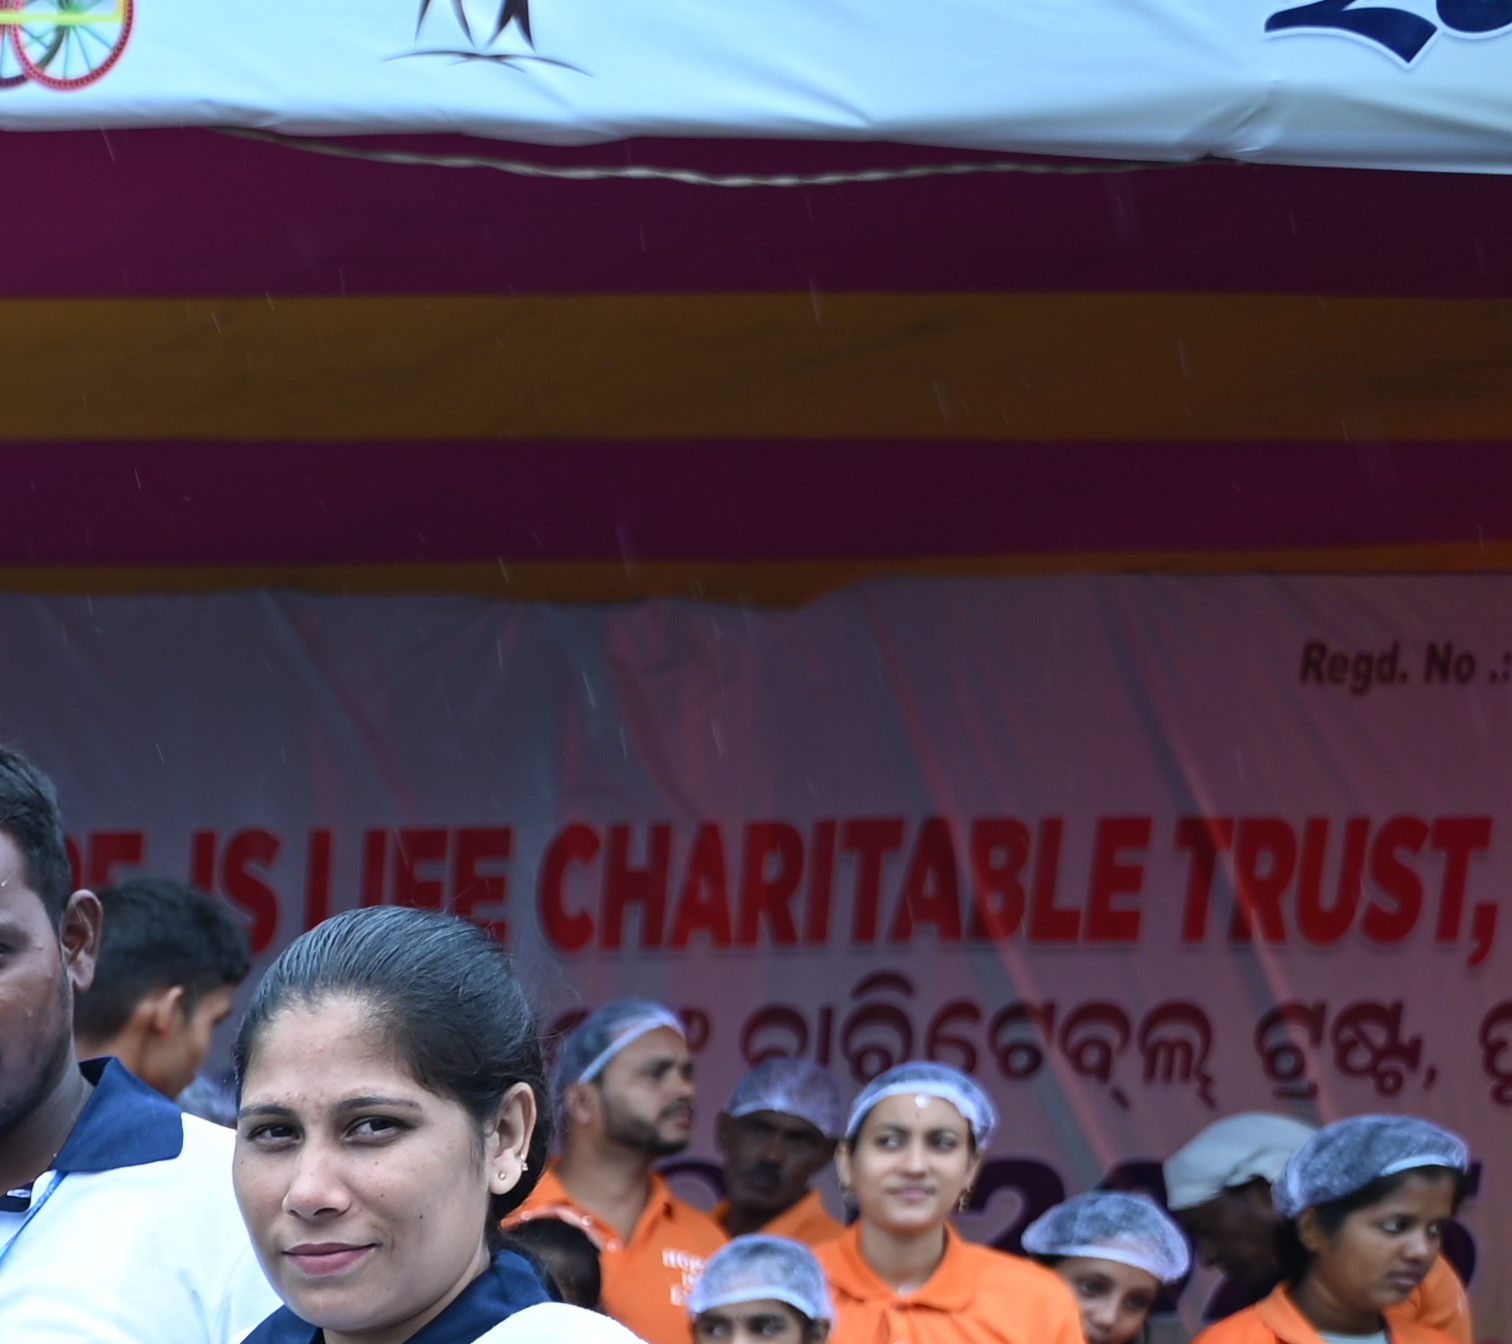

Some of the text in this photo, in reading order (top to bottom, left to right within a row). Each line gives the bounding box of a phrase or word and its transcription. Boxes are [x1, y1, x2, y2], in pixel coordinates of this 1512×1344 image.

[1298, 641, 1408, 696] Regd.
[1423, 640, 1477, 685] No
[536, 813, 1154, 953] CHARITABLE
[1173, 814, 1499, 967] TRUST,
